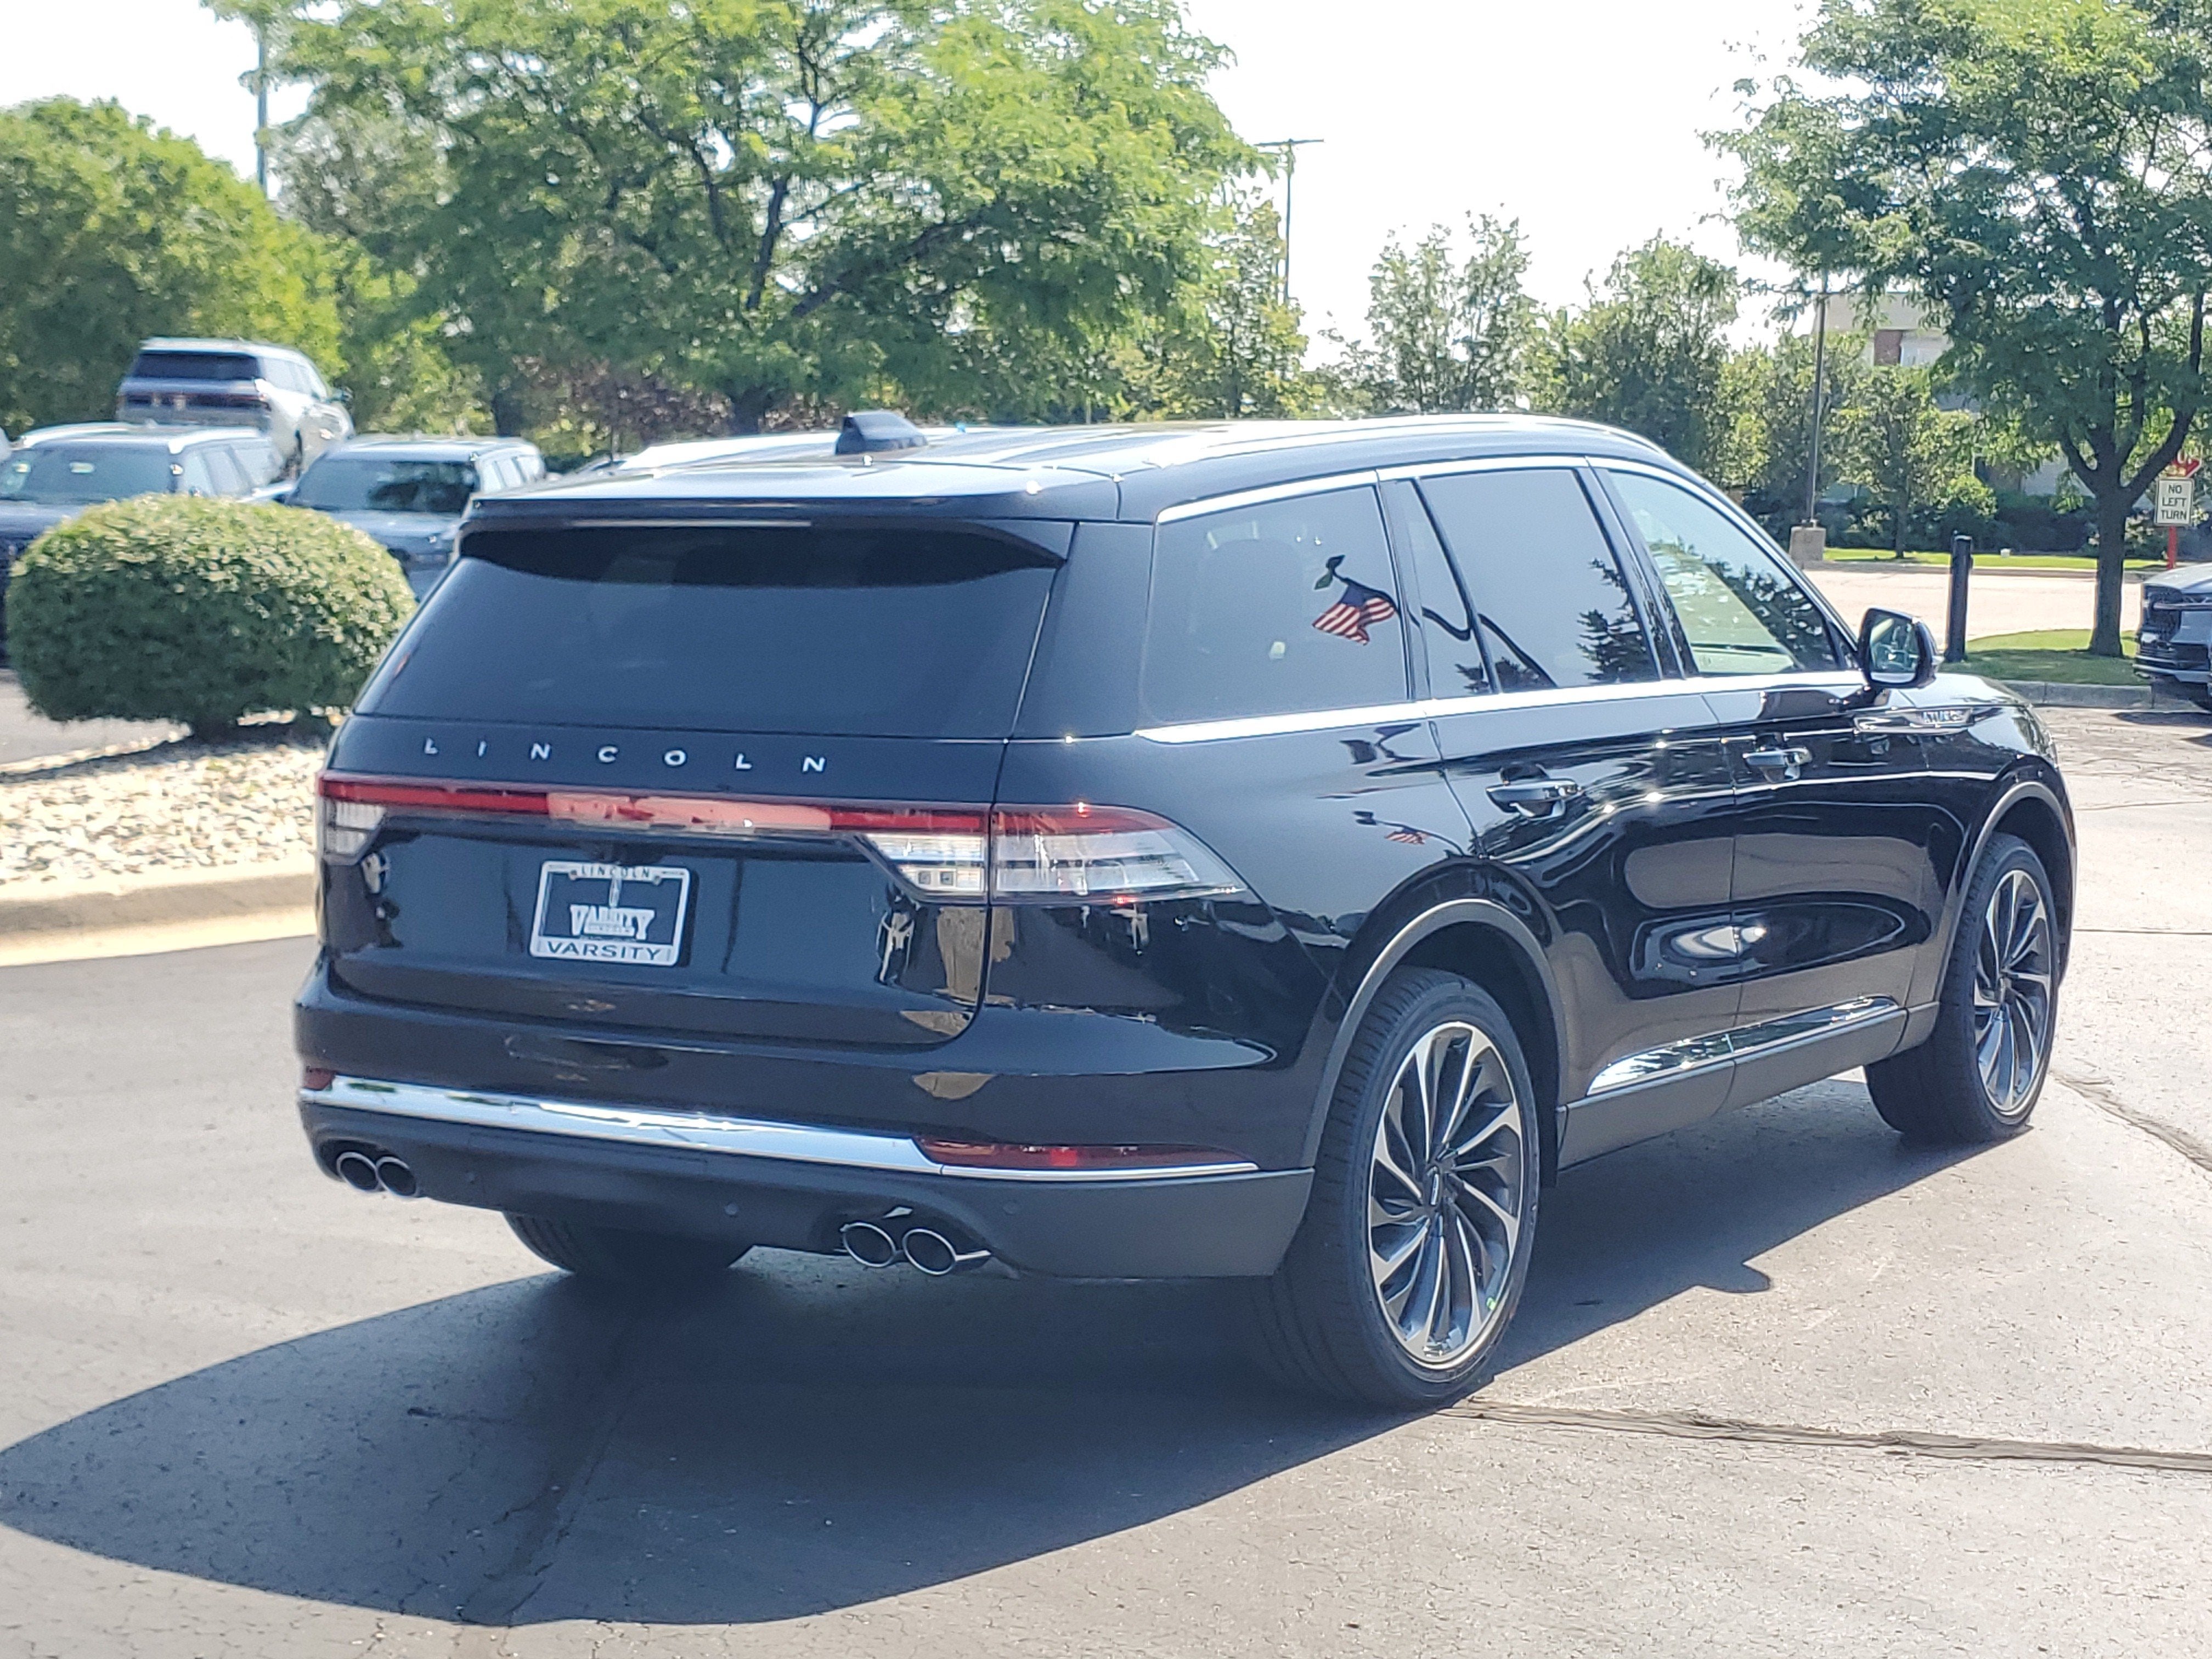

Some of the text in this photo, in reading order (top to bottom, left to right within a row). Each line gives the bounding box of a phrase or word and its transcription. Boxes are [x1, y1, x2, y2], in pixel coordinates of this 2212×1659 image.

[2168, 484, 2182, 494] NO
[2162, 497, 2187, 507] LEFT
[2161, 510, 2187, 520] TURN
[424, 738, 826, 772] LINCOLN
[547, 941, 662, 961] VARSITY
